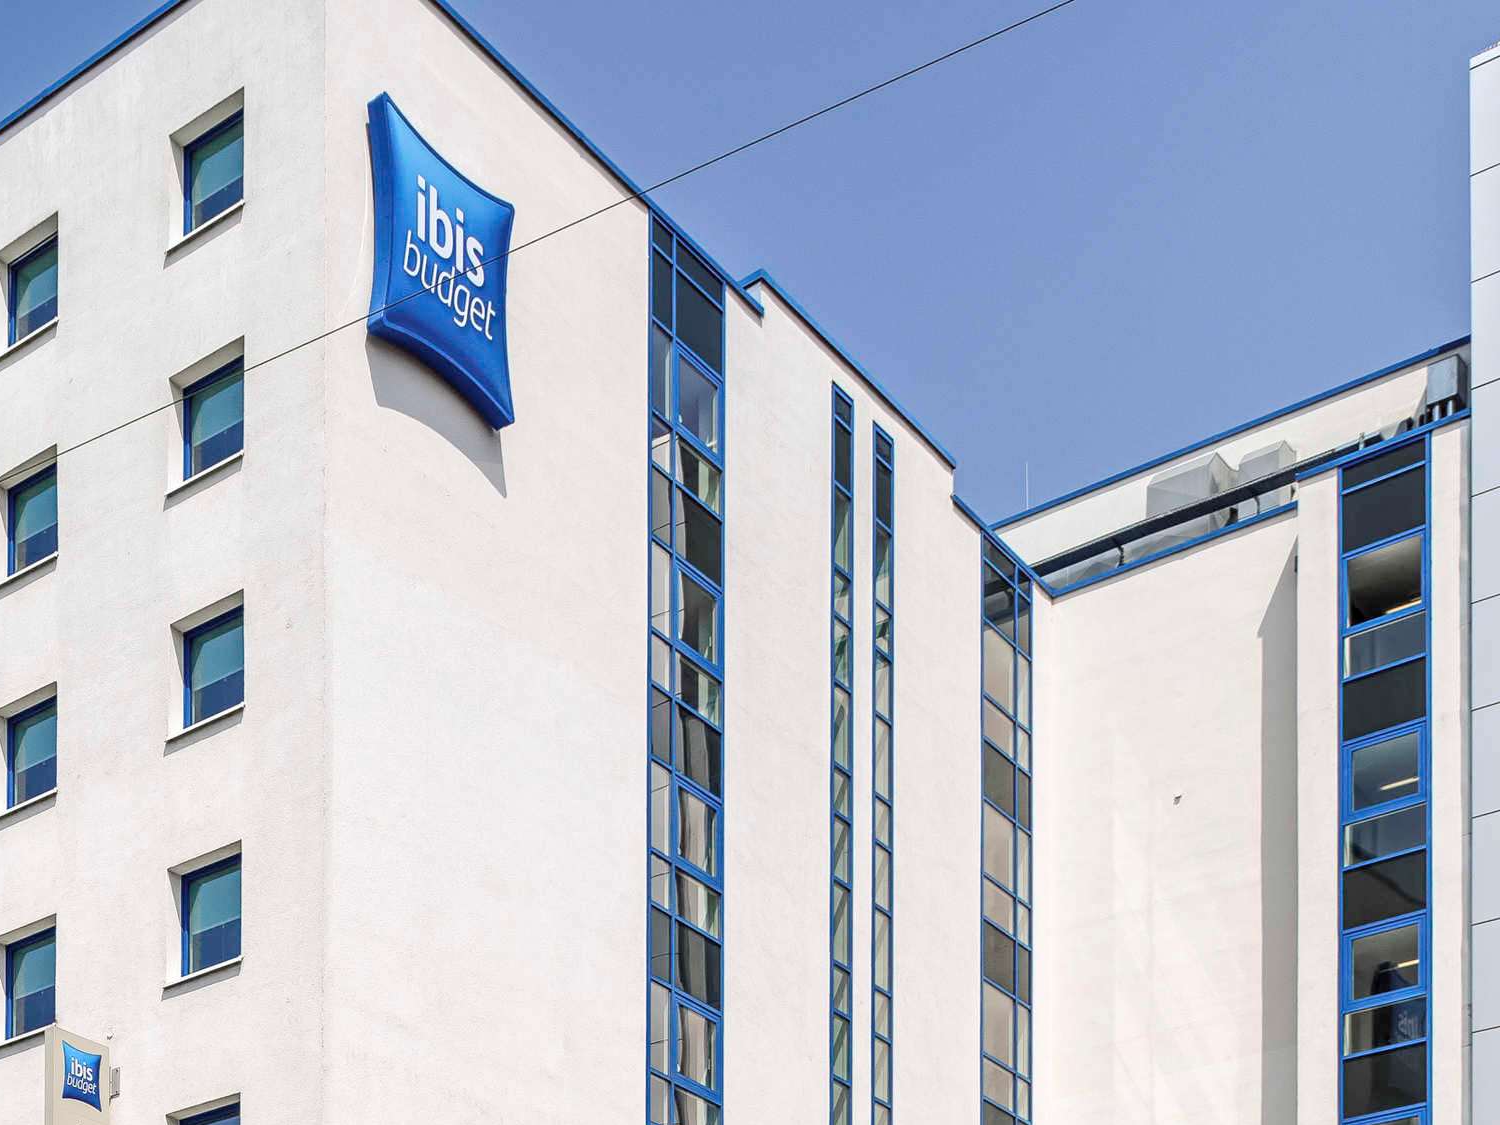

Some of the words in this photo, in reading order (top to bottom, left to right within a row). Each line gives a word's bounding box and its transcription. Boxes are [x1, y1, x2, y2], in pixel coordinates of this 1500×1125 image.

[417, 174, 485, 288] ibis
[403, 229, 496, 341] budget
[66, 1072, 97, 1095] budget
[70, 1056, 93, 1081] ibis
